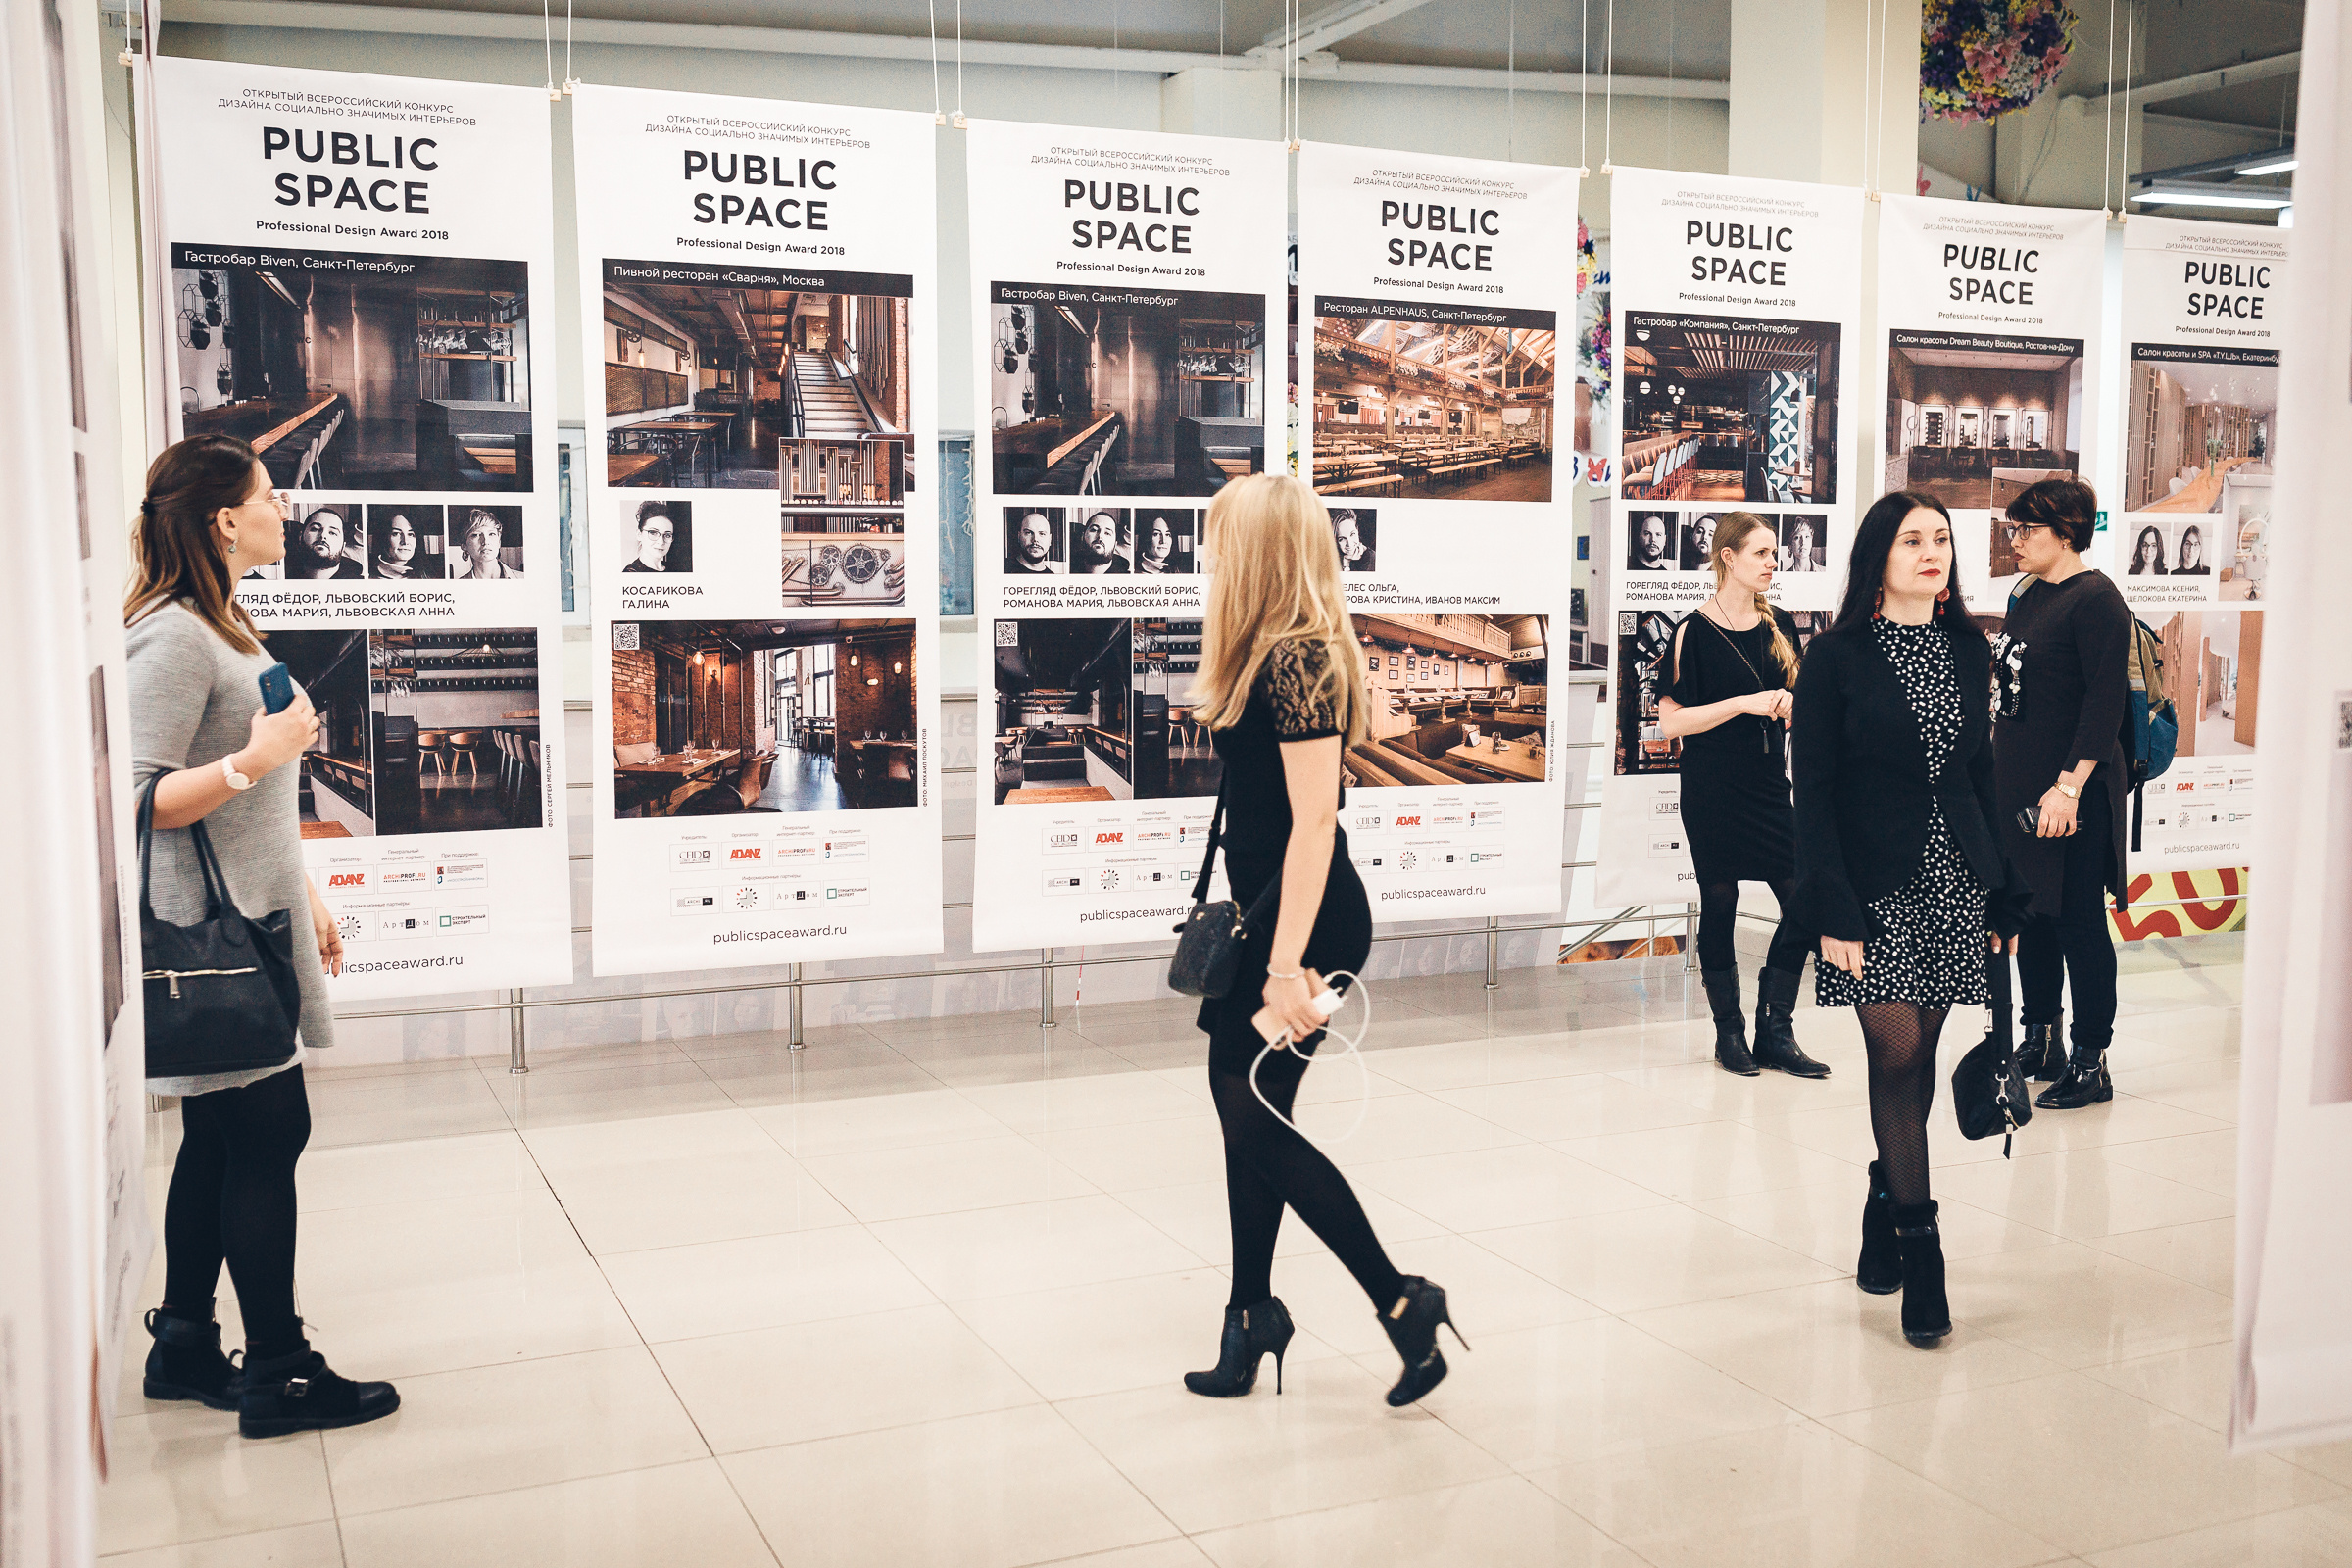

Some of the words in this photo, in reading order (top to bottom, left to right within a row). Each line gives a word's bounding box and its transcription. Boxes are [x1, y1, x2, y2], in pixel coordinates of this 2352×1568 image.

[242, 88, 304, 101] ОТКРЫТЫЙ
[307, 93, 401, 109] ВСЕРОССИЙСКИЙ
[404, 101, 453, 113] КОНКУРС
[218, 98, 271, 110] ДИЗАЙНА
[274, 102, 344, 116] СОЦИАЛЬНО
[347, 108, 406, 121] ЗНАЧИМЫХ
[409, 113, 476, 125] ИНТЕРЬЕРОВ
[645, 123, 692, 134] ДИЗАЙНА
[694, 127, 756, 139] СОЦИАЛЬНО
[758, 132, 808, 144] ЗНАЧИМЫХ
[811, 136, 870, 149] ИНТЕРЬЕРОВ
[666, 115, 720, 125] ОТКРЫТЫЙ
[722, 119, 806, 132] ВСЕРОССИЙСКИЙ
[808, 125, 851, 137] КОНКУРС
[263, 125, 438, 171] PUBLIC
[1050, 146, 1098, 157] ОТКРЫТЫЙ
[1100, 150, 1173, 162] ВСЕРОССИЙСКИЙ
[1174, 156, 1212, 166] КОНКУРС
[684, 149, 837, 190] PUBLIC
[1030, 155, 1072, 165] ДИЗАЙНА
[1074, 158, 1128, 170] СОЦИАЛЬНО
[1130, 162, 1176, 172] ЗНАЧИМЫХ
[1177, 166, 1230, 176] ИНТЕРЬЕРОВ
[1353, 176, 1390, 186] ДИЗАЙНА
[1392, 180, 1440, 191] СОЦИАЛЬНО
[1440, 185, 1481, 195] ЗНАЧИМЫХ
[1482, 189, 1527, 199] ИНТЕРЬЕРОВ
[1372, 169, 1414, 179] ОТКРЫТЫЙ
[1415, 172, 1480, 185] ВСЕРОССИЙСКИЙ
[1481, 179, 1514, 189] КОНКУРС
[274, 172, 429, 214] SPACE
[1064, 178, 1200, 216] PUBLIC
[693, 192, 828, 231] SPACE
[1381, 200, 1499, 236] PUBLIC
[256, 220, 330, 233] Professional
[334, 224, 376, 237] Design
[379, 227, 417, 238] Award
[421, 229, 449, 240] 2018
[1071, 219, 1191, 254] SPACE
[1687, 220, 1793, 252] PUBLIC
[676, 236, 742, 249] Professional
[745, 240, 781, 253] Design
[784, 243, 817, 254] Award
[820, 245, 845, 256] 2018
[1387, 237, 1492, 271] SPACE
[185, 250, 256, 267] Гастробар
[260, 254, 298, 268] Biven,
[302, 256, 415, 274] Санкт-Петербург
[1056, 260, 1114, 271] Professional
[1117, 264, 1150, 274] Design
[1152, 266, 1181, 275] Award
[1184, 267, 1205, 276] 2018
[1943, 243, 2039, 273] PUBLIC
[613, 266, 660, 277] Пивной
[662, 270, 718, 281] ресторан
[722, 271, 779, 285] «Сварня»,
[782, 274, 824, 286] Москва
[1690, 255, 1786, 286] SPACE
[2184, 261, 2271, 289] PUBLIC
[1373, 276, 1424, 288] Professional
[1426, 280, 1455, 291] Design
[1456, 282, 1483, 292] Award
[1485, 284, 1503, 294] 2018
[1949, 276, 2033, 305] SPACE
[1001, 287, 1055, 301] Гастробар
[1058, 290, 1089, 302] Biven,
[1091, 291, 1178, 307] Санкт-Петербург
[1679, 292, 1725, 302] Professional
[1726, 295, 1752, 305] Design
[1753, 297, 1778, 306] Award
[1779, 298, 1796, 307] 2018
[2186, 292, 2264, 319] SPACE
[1323, 301, 1368, 314] Ресторан
[1370, 305, 1429, 318] ALPENHAUS,
[1431, 309, 1507, 323] Санкт-Петербург
[1937, 311, 1979, 320] Professional
[1980, 314, 2002, 322] Design
[1633, 316, 1677, 328] Гастробар
[1679, 318, 1730, 331] «Компания»,
[1732, 321, 1799, 335] Санкт-Петербург
[2175, 325, 2214, 334] Professional
[2215, 327, 2236, 336] Design
[1896, 334, 1919, 343] Салон
[1949, 336, 1971, 345] Dream
[1972, 338, 1994, 348] Beauty
[1994, 339, 2024, 349] Boutique,
[2025, 340, 2074, 353] Ростов-на-Дону
[2137, 347, 2161, 356] Салон
[2197, 350, 2211, 359] SPA
[2242, 352, 2280, 364] Екатеринбу
[622, 586, 704, 595] КОСАРИКОВА
[1004, 586, 1057, 596] ГОРЕГЛЯД
[1059, 586, 1098, 596] ФЁДОР,
[1100, 584, 1161, 596] ЛЬВОВСКИЙ
[1164, 586, 1200, 596] БОРИС,
[1367, 583, 1399, 593] ОЛЬГА,
[1626, 581, 1669, 591] ГОРЕГЛЯД
[1670, 581, 1701, 590] ФЁДОР,
[2172, 585, 2199, 594] КСЕНИЯ,
[235, 594, 270, 605] ГЛЯД
[271, 591, 321, 605] ФЁДОР,
[324, 591, 405, 603] ЛЬВОВСКИЙ
[409, 593, 455, 604] БОРИС,
[622, 599, 670, 609] ГАЛИНА
[1004, 599, 1063, 608] РОМАНОВА
[1066, 599, 1104, 608] МАРИЯ,
[1106, 598, 1169, 607] ЛЬВОВСКАЯ
[1171, 598, 1200, 607] АННА
[1372, 595, 1423, 605] КРИСТИНА,
[1425, 595, 1462, 604] ИВАНОВ
[1464, 596, 1500, 605] МАКСИМ
[1626, 592, 1674, 601] РОМАНОВА
[282, 608, 331, 618] МАРИЯ,
[334, 607, 415, 617] ЛЬВОВСКАЯ
[418, 607, 455, 616] АННА
[2163, 841, 2240, 855] publicspaceaward.ru
[1381, 885, 1486, 901] publicspaceaward.ru
[1080, 905, 1192, 923] publicspaceaward.r
[713, 924, 847, 945] publicspaceaward.ru
[325, 956, 463, 975] licspaceaward.ru
